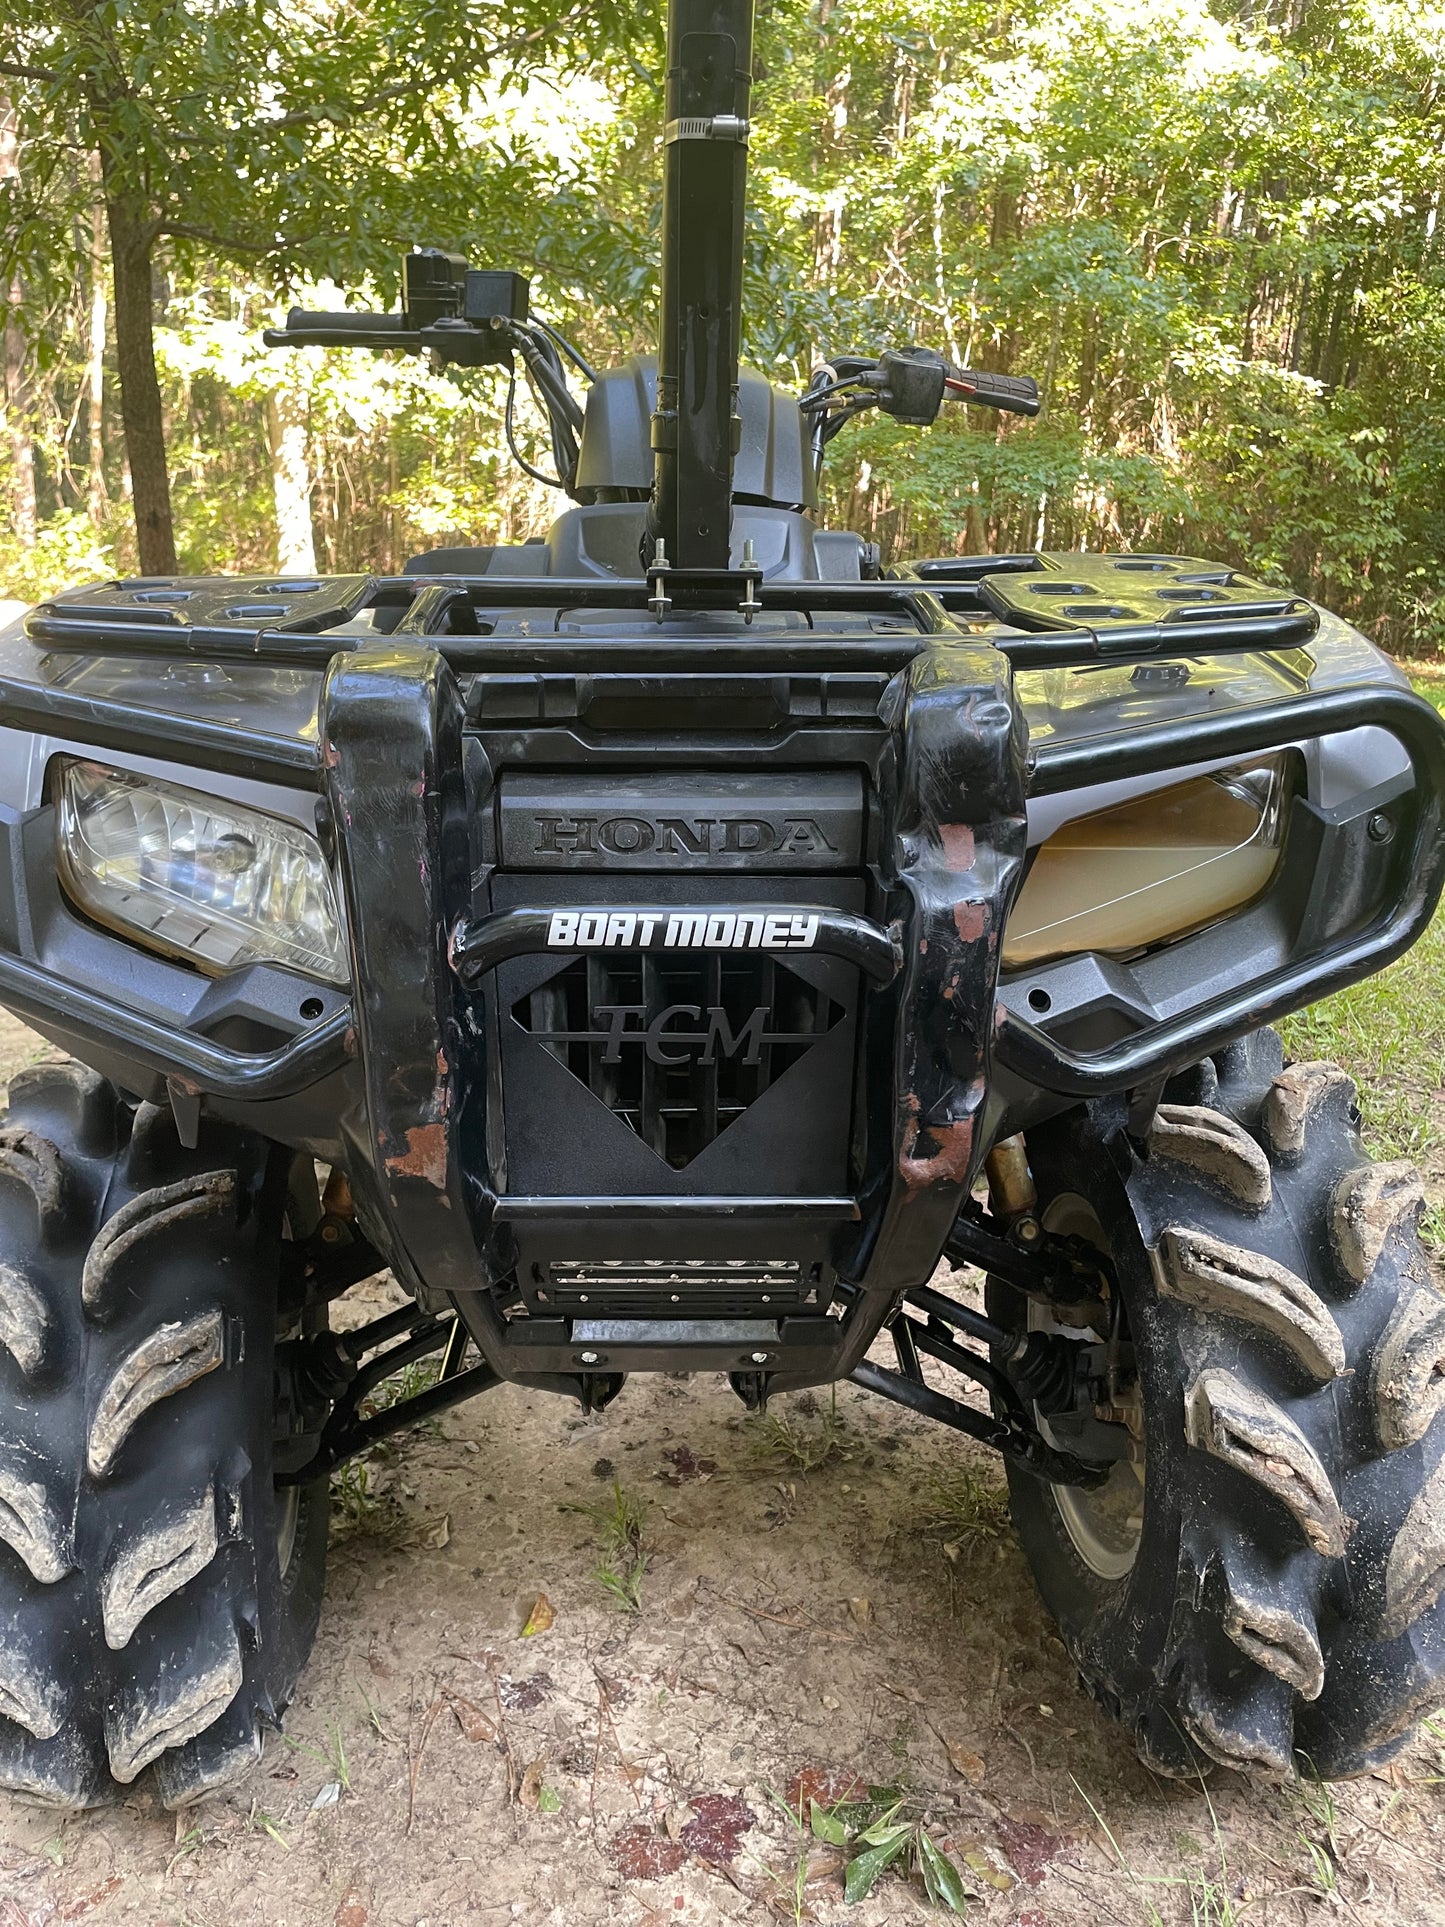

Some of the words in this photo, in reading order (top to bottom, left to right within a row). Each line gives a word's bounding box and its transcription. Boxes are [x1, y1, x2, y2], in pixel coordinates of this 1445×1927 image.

[534, 817, 838, 856] HONDA
[547, 912, 663, 947] BOAT
[663, 913, 819, 948] MONEY
[593, 1004, 771, 1065] TCM
